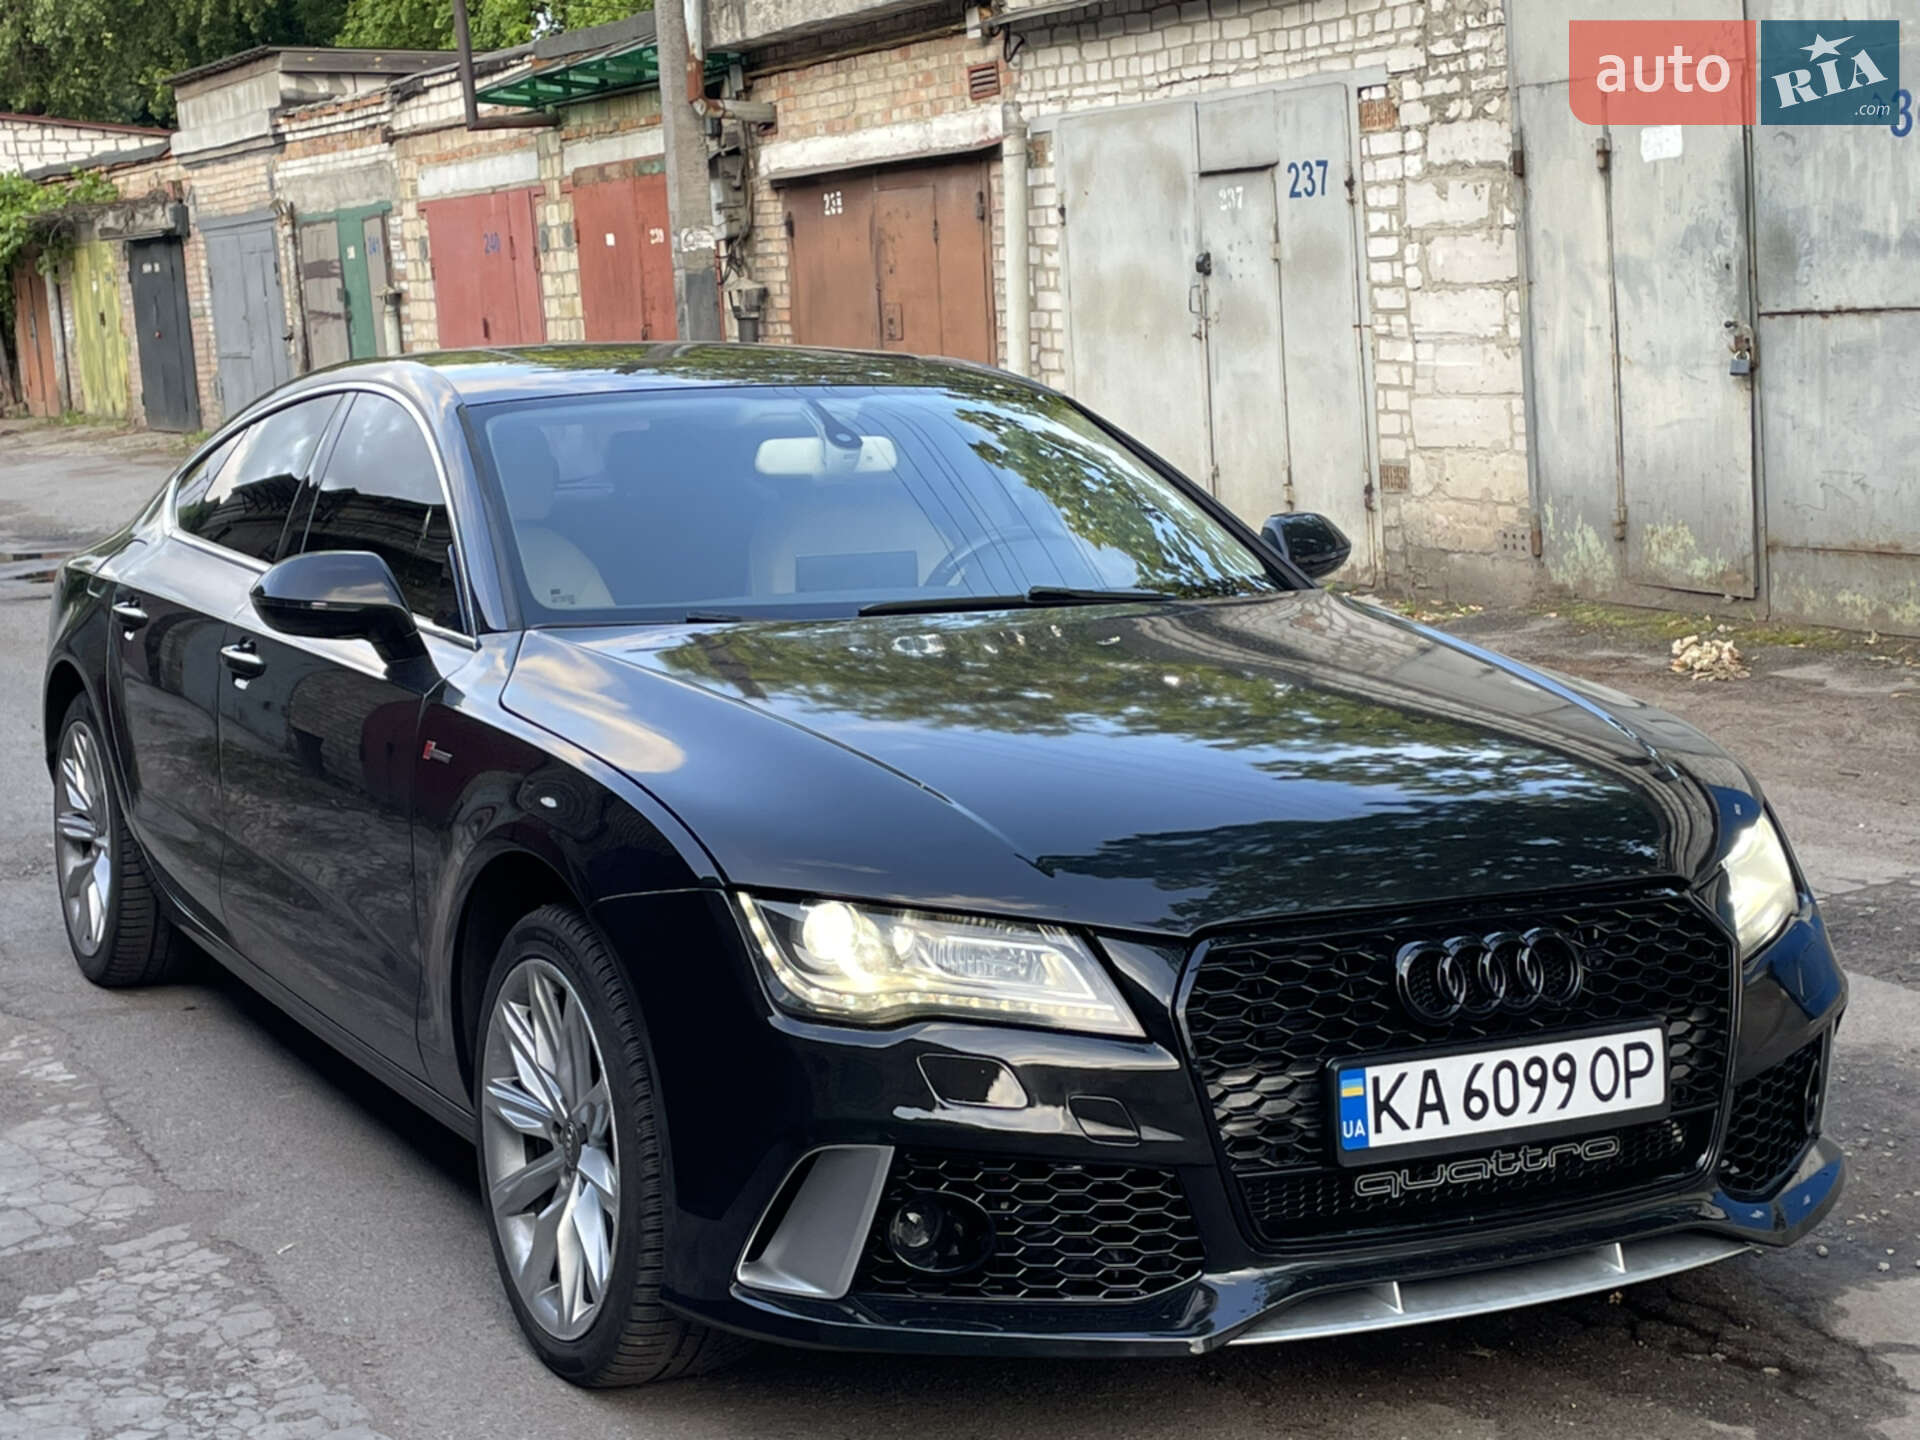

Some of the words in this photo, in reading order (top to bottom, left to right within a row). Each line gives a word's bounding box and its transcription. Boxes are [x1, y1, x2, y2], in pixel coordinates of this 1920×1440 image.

[1287, 159, 1329, 199] 237
[1371, 1067, 1450, 1135] KA
[1462, 1051, 1577, 1122] 6099
[1589, 1041, 1654, 1103] OP
[1343, 1119, 1366, 1138] UA
[1354, 1135, 1621, 1199] quattro
